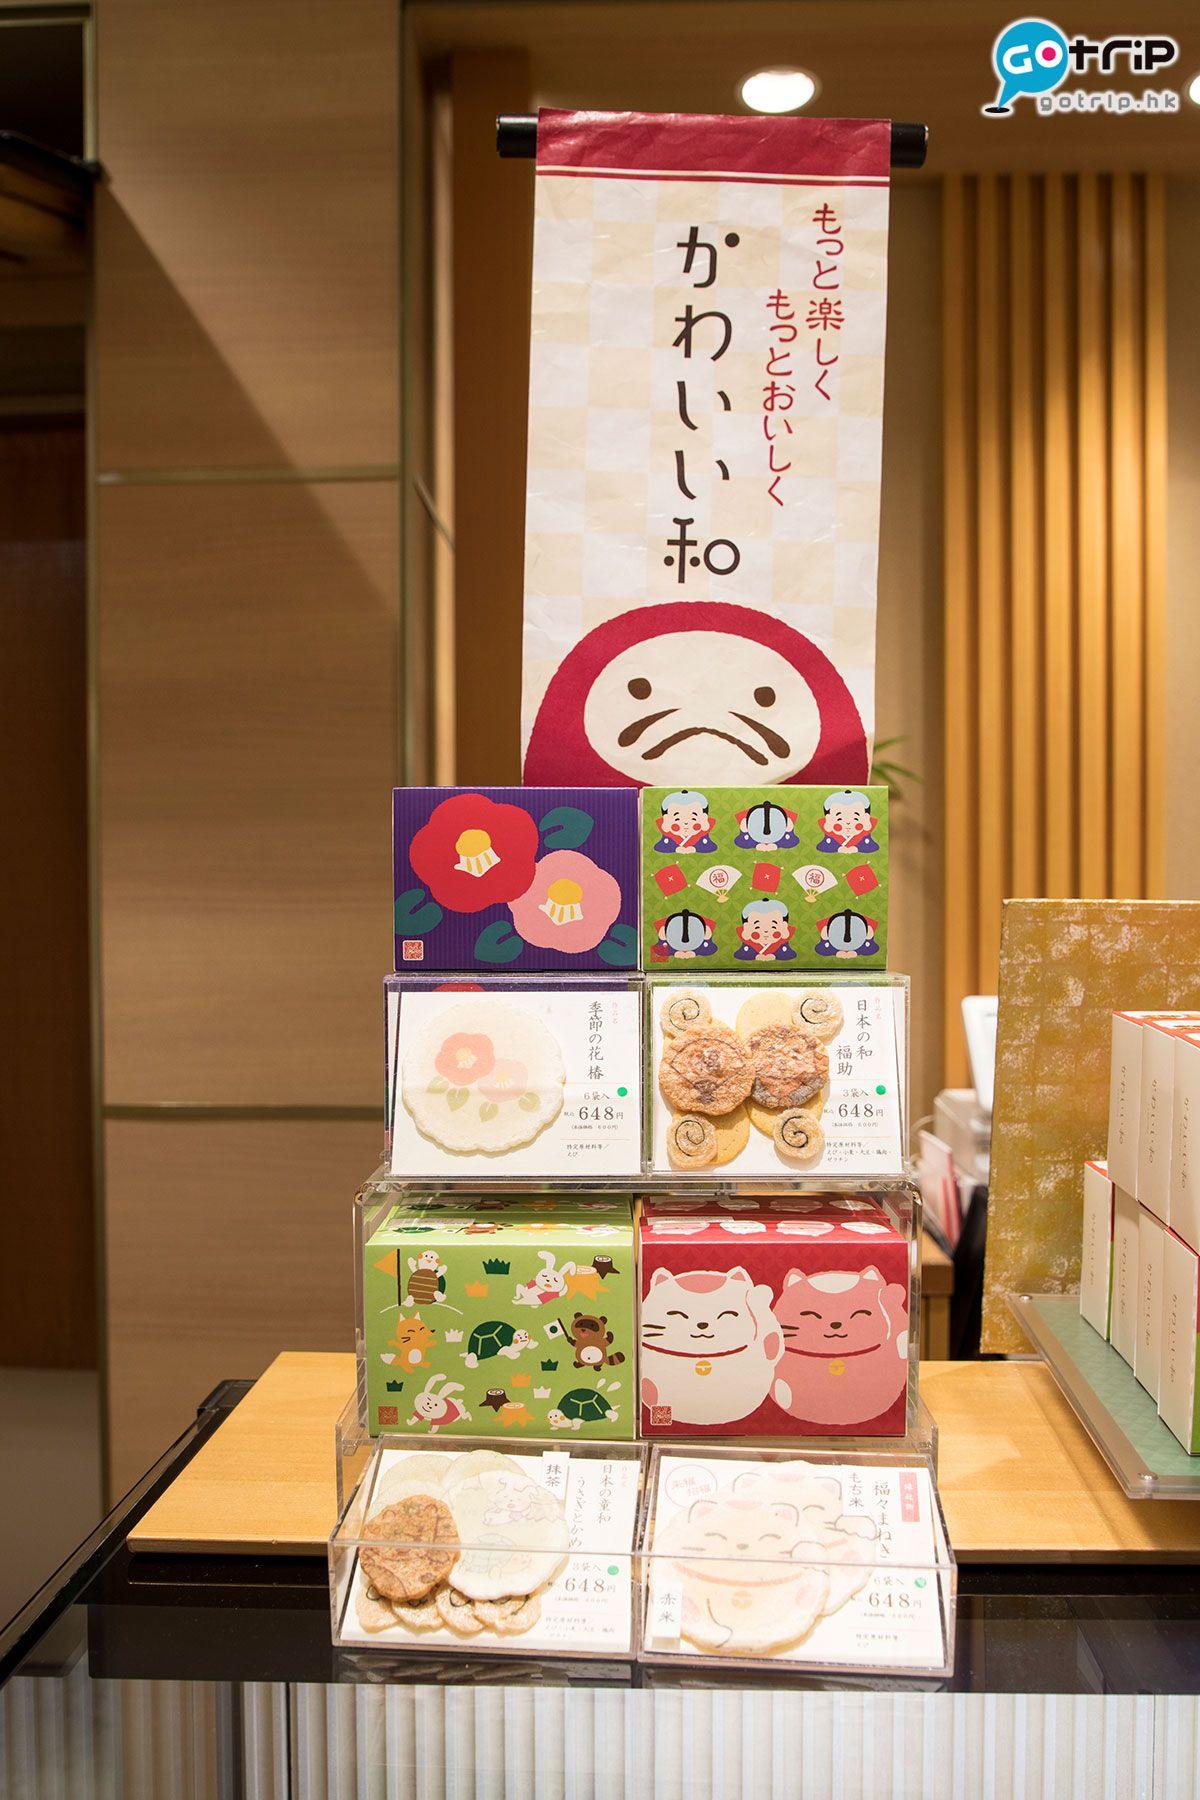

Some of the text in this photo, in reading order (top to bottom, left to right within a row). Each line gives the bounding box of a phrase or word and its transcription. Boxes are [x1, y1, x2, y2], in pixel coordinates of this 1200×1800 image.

[805, 202, 845, 401] もっと楽しく
[663, 226, 741, 584] かわいい和
[762, 288, 798, 507] もっとおいしく
[711, 872, 726, 885] 福
[807, 872, 823, 886] 福
[855, 999, 873, 1060] 日本の和
[835, 1045, 853, 1076] 福助
[583, 1091, 610, 1101] 6袋入
[838, 1103, 884, 1118] 648円
[578, 1106, 624, 1121] 648円
[545, 1464, 562, 1488] 抹茶
[848, 1472, 864, 1508] もち米
[657, 1592, 677, 1624] 赤米
